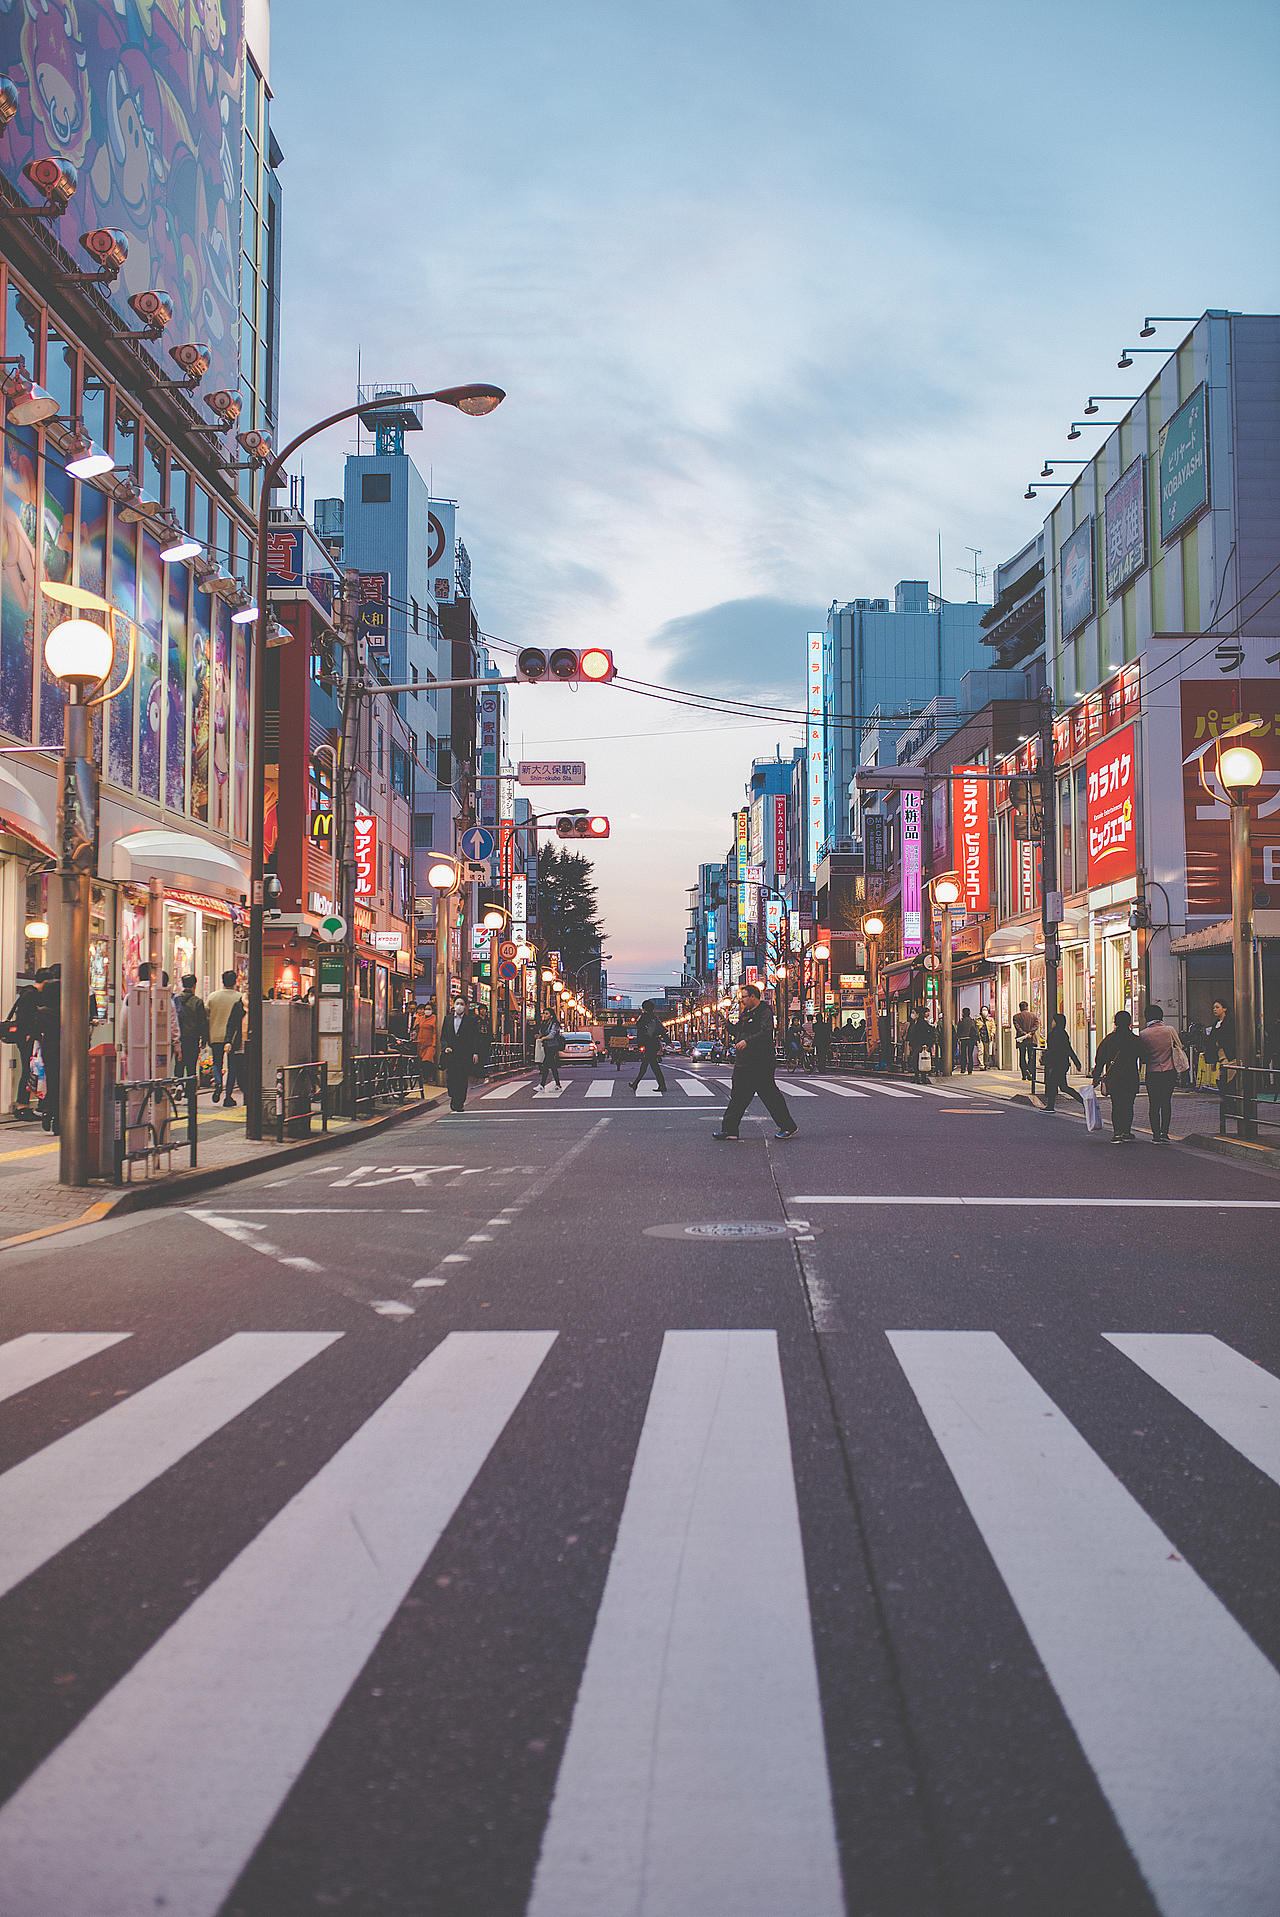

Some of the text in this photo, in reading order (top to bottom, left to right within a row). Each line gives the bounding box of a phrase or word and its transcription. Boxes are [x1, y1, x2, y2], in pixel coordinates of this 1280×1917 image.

[1168, 429, 1198, 473] ビリヤード
[1163, 448, 1203, 503] KOBAYASHI
[1110, 499, 1139, 566] 英雄
[483, 721, 495, 747] 家具
[521, 765, 582, 775] 新大久保駅前
[1088, 753, 1131, 804] カラオケ
[904, 792, 920, 840] 化粧品
[963, 769, 980, 909] カラオケ ビッグエコー
[355, 835, 372, 893] アイフル
[503, 946, 514, 956] 40
[905, 946, 920, 955] TAX
